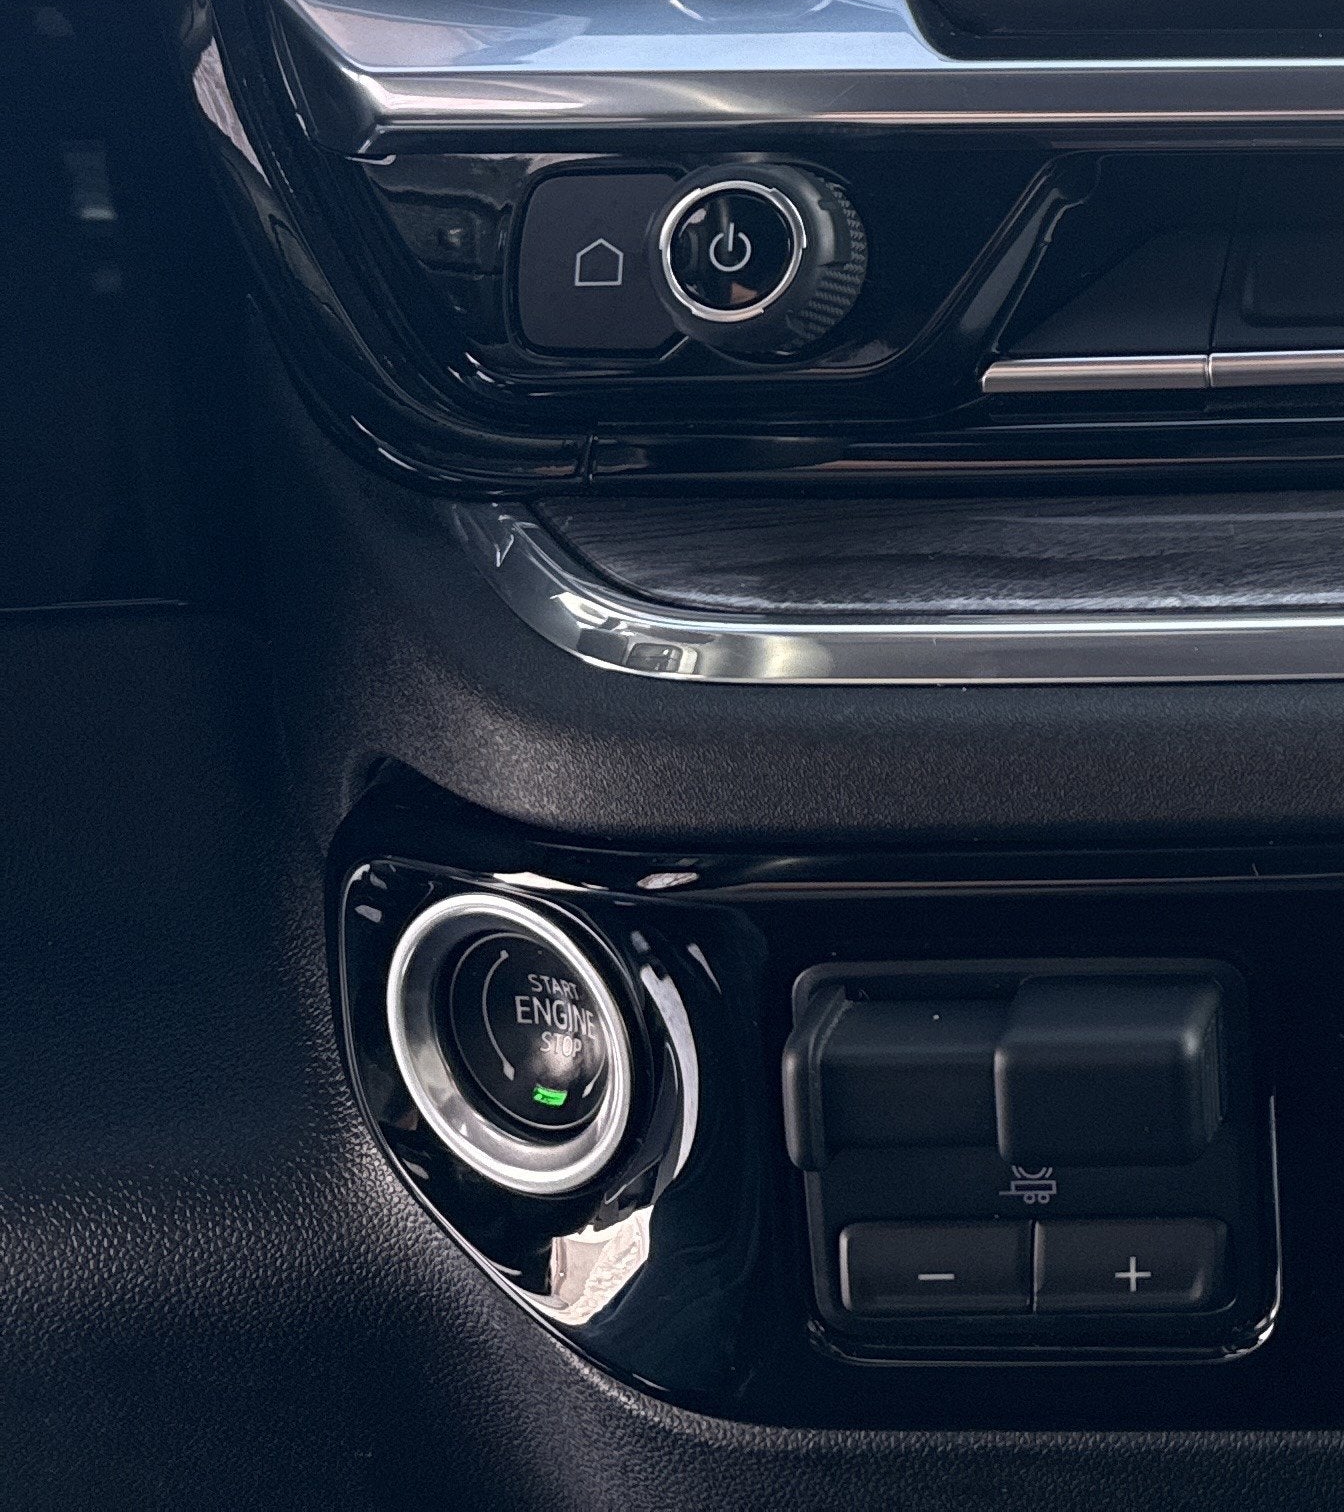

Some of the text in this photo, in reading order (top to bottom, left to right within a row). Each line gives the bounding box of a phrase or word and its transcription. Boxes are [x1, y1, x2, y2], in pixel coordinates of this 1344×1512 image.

[527, 973, 580, 1001] START
[515, 995, 597, 1039] ENGINE
[540, 1031, 582, 1058] STOP
